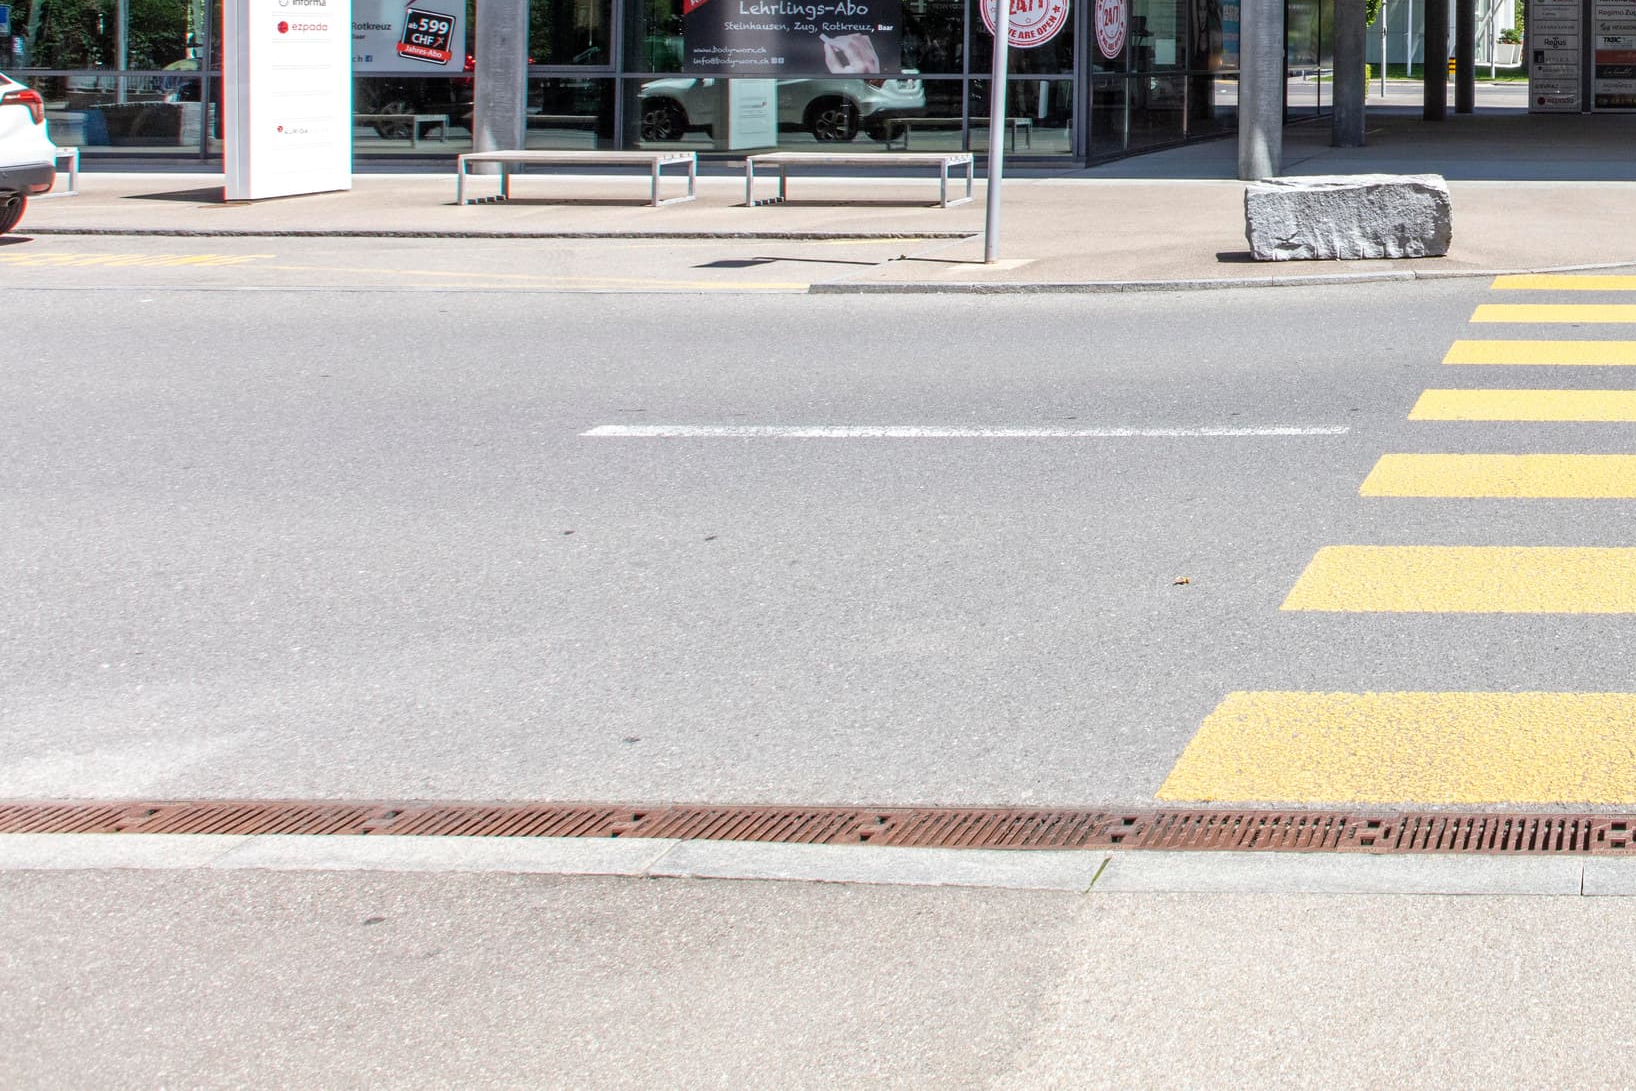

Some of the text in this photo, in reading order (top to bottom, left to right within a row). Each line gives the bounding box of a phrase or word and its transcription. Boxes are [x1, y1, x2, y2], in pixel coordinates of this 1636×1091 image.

[739, 0, 869, 21] Lehrlings-Abo
[1104, 5, 1119, 26] 24/7
[418, 18, 449, 34] 599
[724, 21, 790, 32] Steinhausen,
[794, 22, 818, 33] Zug,
[822, 22, 875, 32] Rotkreuz,
[1018, 30, 1036, 39] ARE
[1036, 15, 1057, 35] OPEN
[412, 33, 434, 45] CHF
[1544, 37, 1567, 48] Regus
[405, 45, 443, 57] Jahres-Abo
